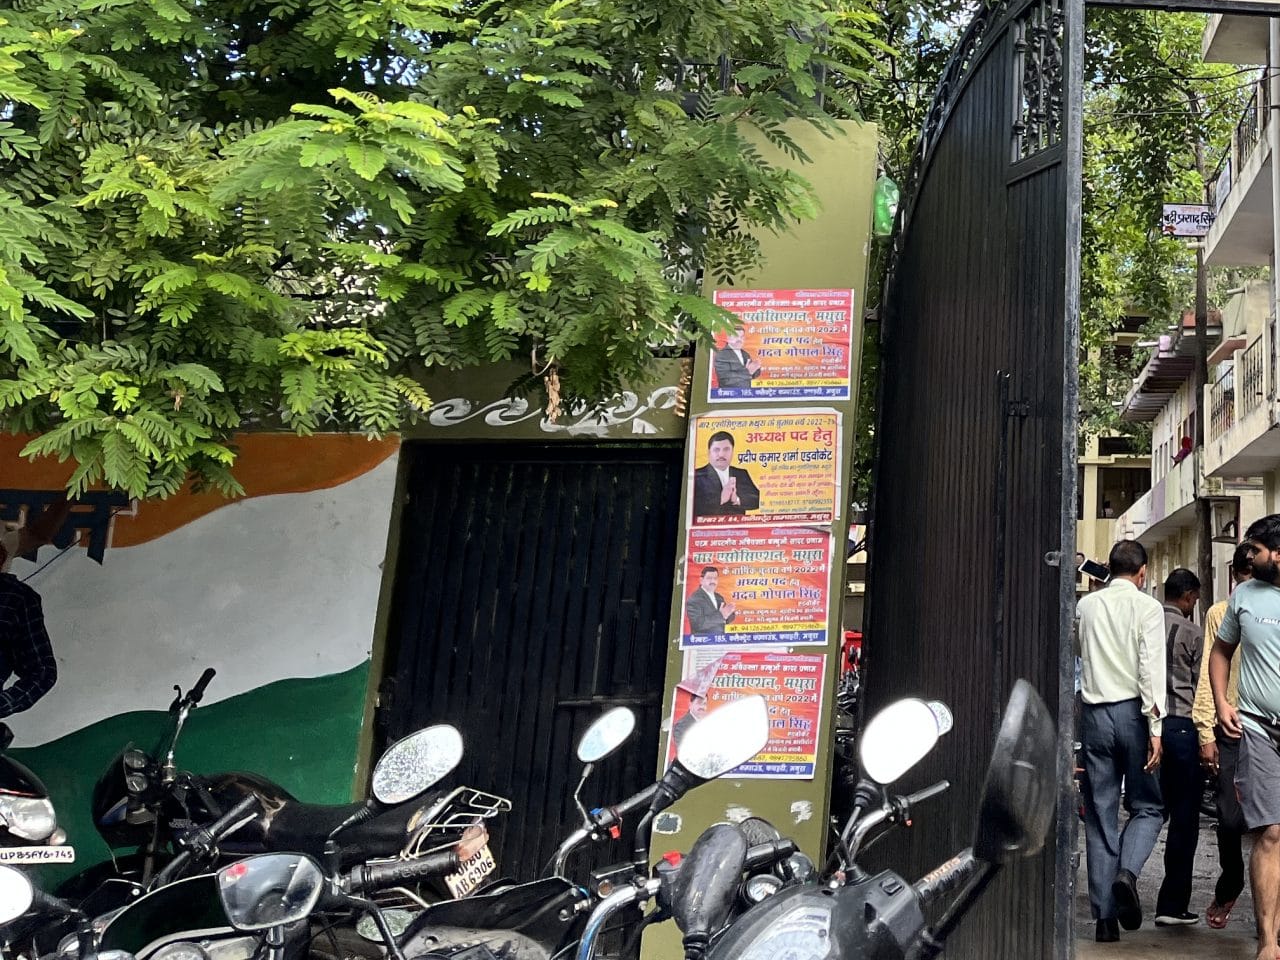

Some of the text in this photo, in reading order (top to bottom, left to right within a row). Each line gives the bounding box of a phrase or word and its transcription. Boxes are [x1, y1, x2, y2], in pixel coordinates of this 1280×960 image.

[815, 310, 846, 326] मथुरा
[757, 347, 782, 358] मदन
[785, 345, 820, 358] गोपाल
[746, 426, 833, 446] अध्यक्ष पद हेतु
[737, 447, 833, 468] प्रदीप कुमार शर्मा एडवोकेट
[693, 551, 714, 564] बार
[791, 549, 825, 567] मथुरा
[794, 566, 817, 574] 2022
[736, 577, 768, 587] अध्यक्ष
[771, 576, 787, 586] पद
[731, 584, 822, 601] मदन गोपाल सिंह
[712, 672, 817, 693] सोसिएशन, मथुरा
[786, 695, 810, 703] 2022
[789, 715, 811, 730] सिंह
